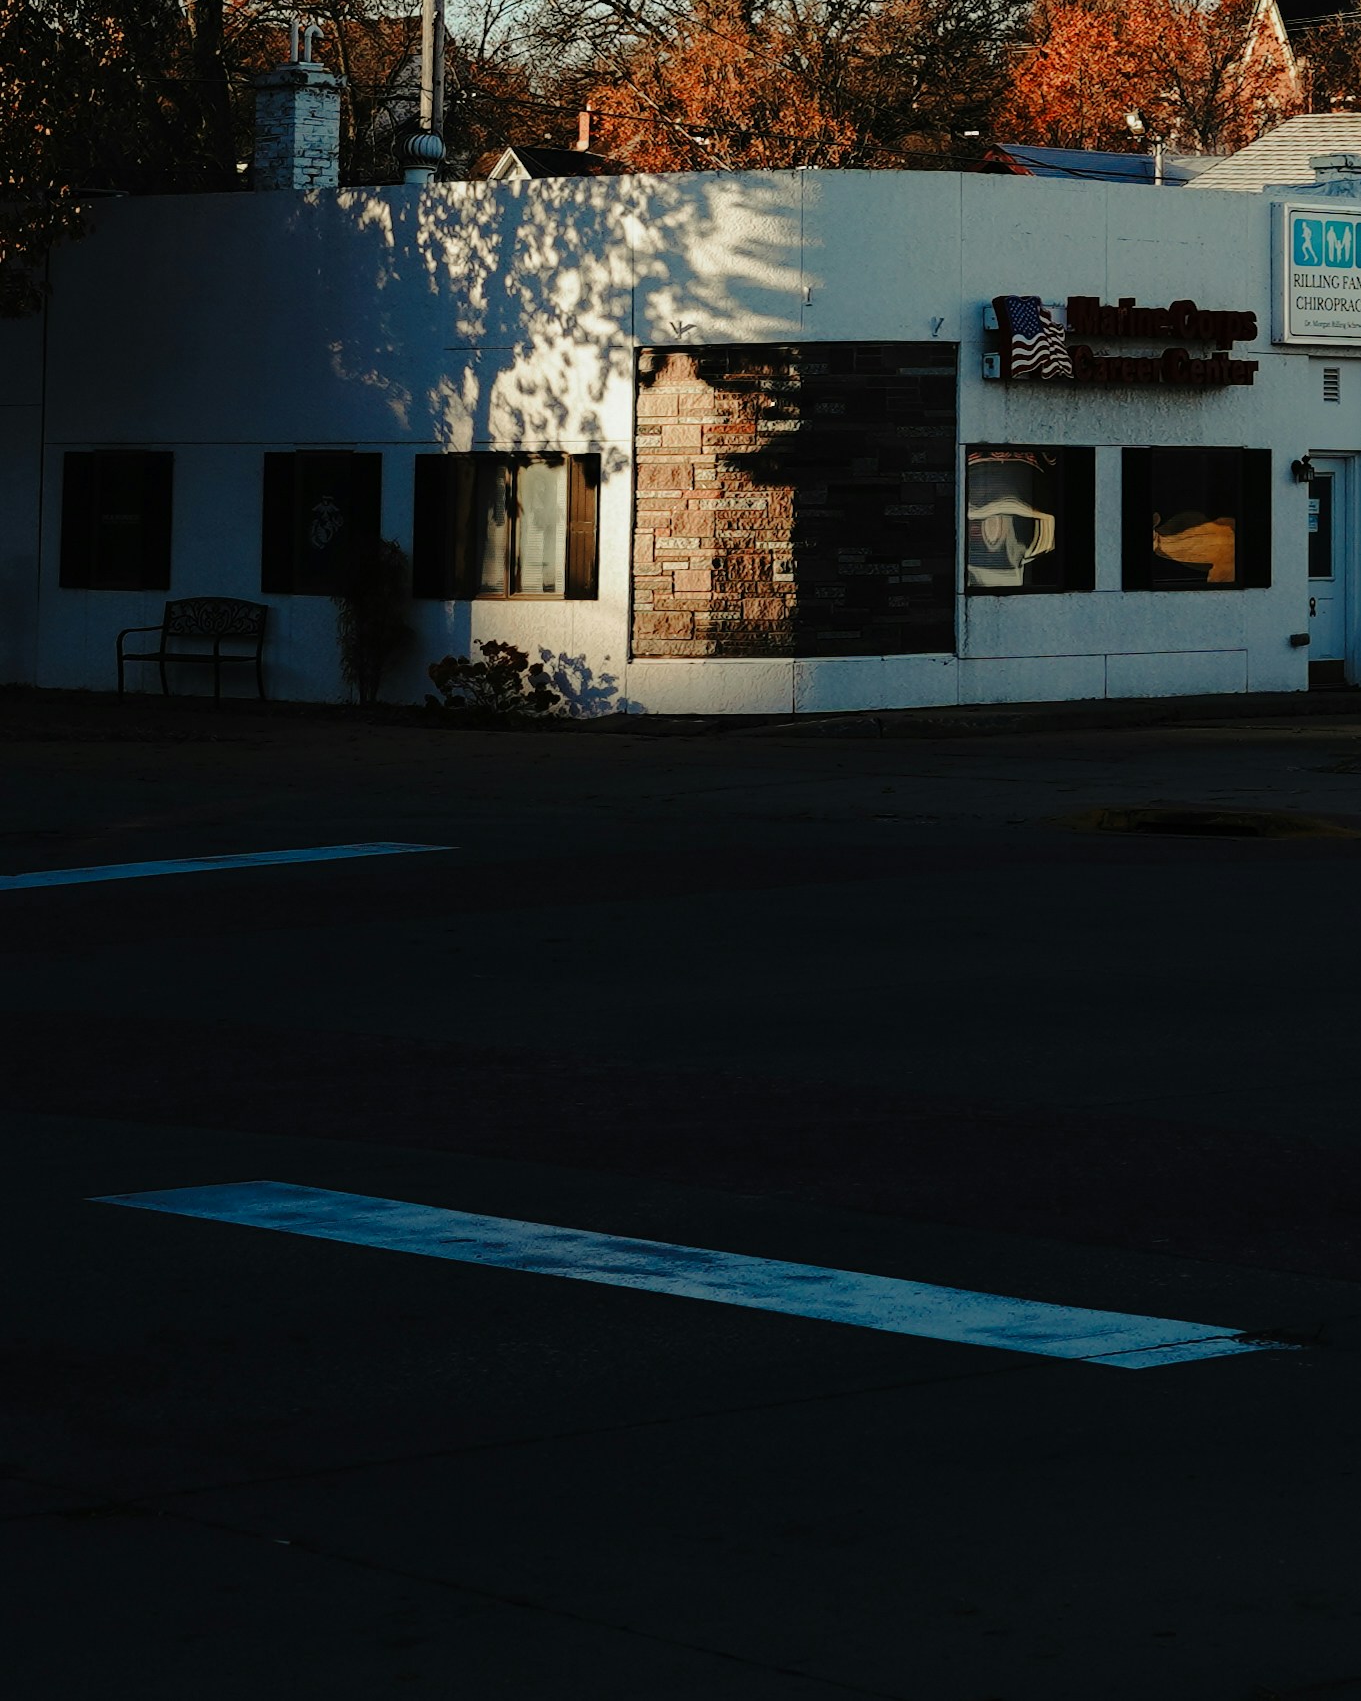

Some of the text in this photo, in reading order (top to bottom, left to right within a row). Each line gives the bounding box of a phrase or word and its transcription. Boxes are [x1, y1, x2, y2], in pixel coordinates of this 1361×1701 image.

[1294, 274, 1340, 290] RILLING
[1067, 296, 1258, 350] Marine Corps
[1069, 345, 1259, 386] Career Center
